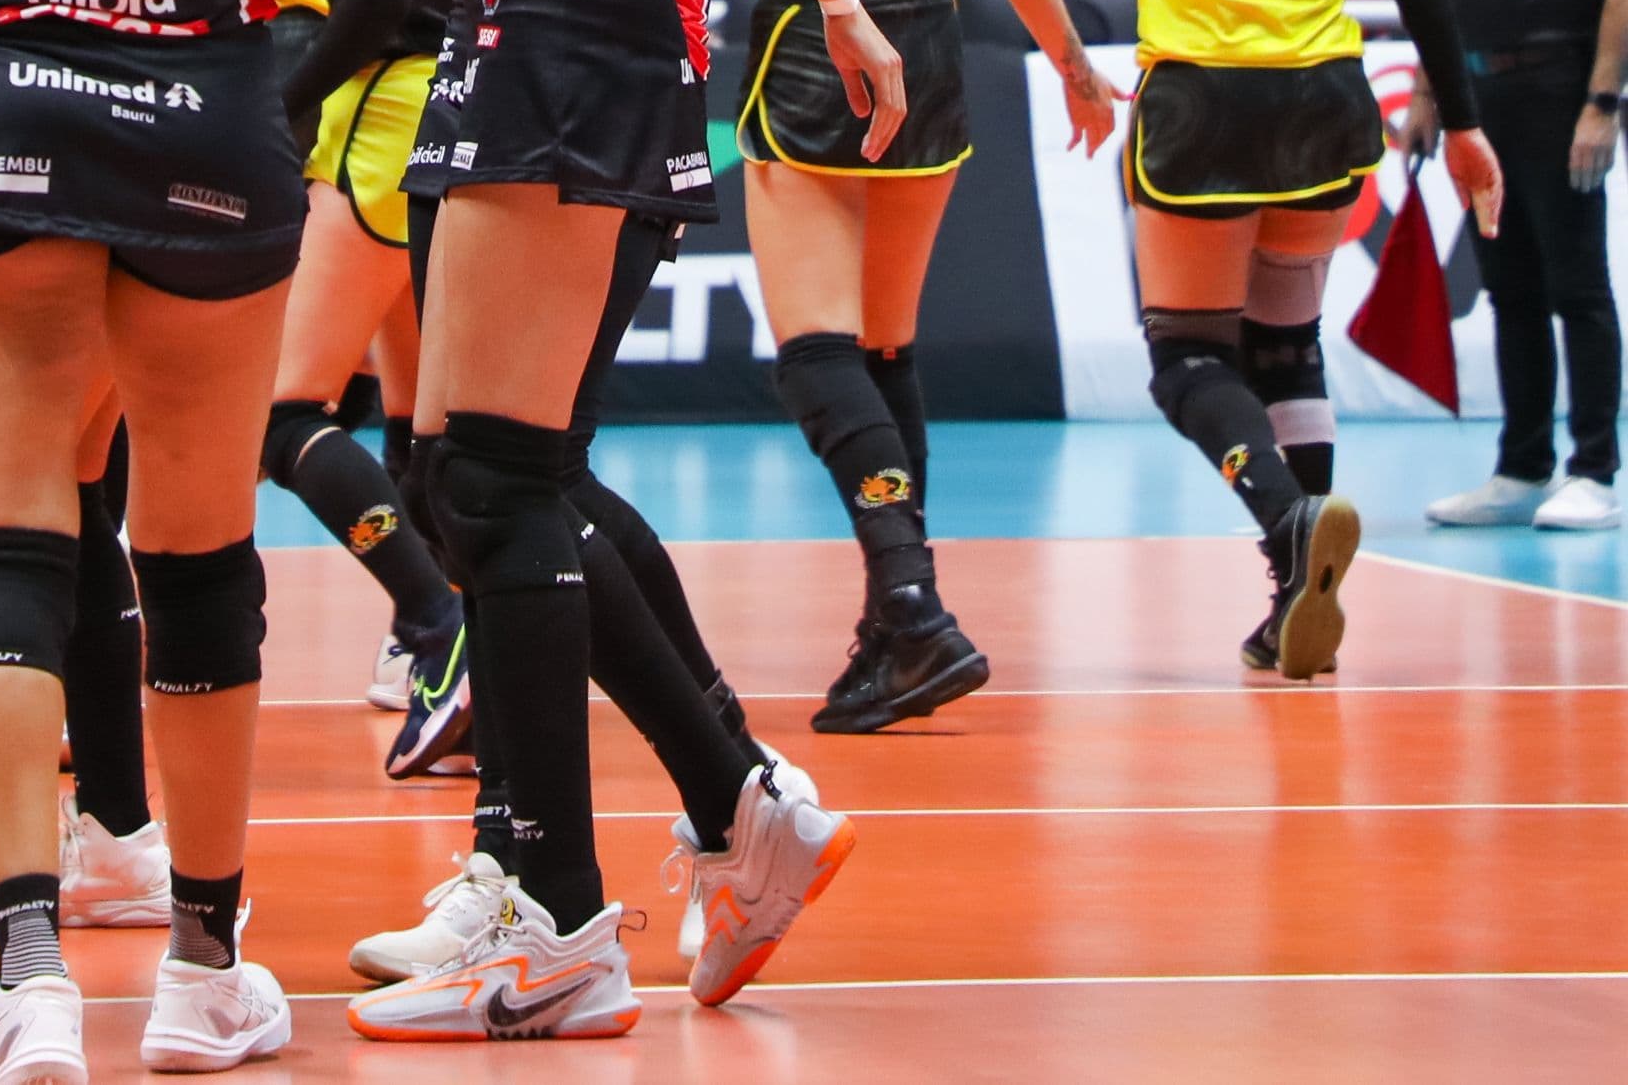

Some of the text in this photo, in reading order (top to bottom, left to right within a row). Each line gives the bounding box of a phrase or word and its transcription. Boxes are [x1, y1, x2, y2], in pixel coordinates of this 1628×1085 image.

[8, 61, 156, 105] Unimed
[111, 105, 155, 124] Bauru
[154, 679, 212, 693] PENALTY
